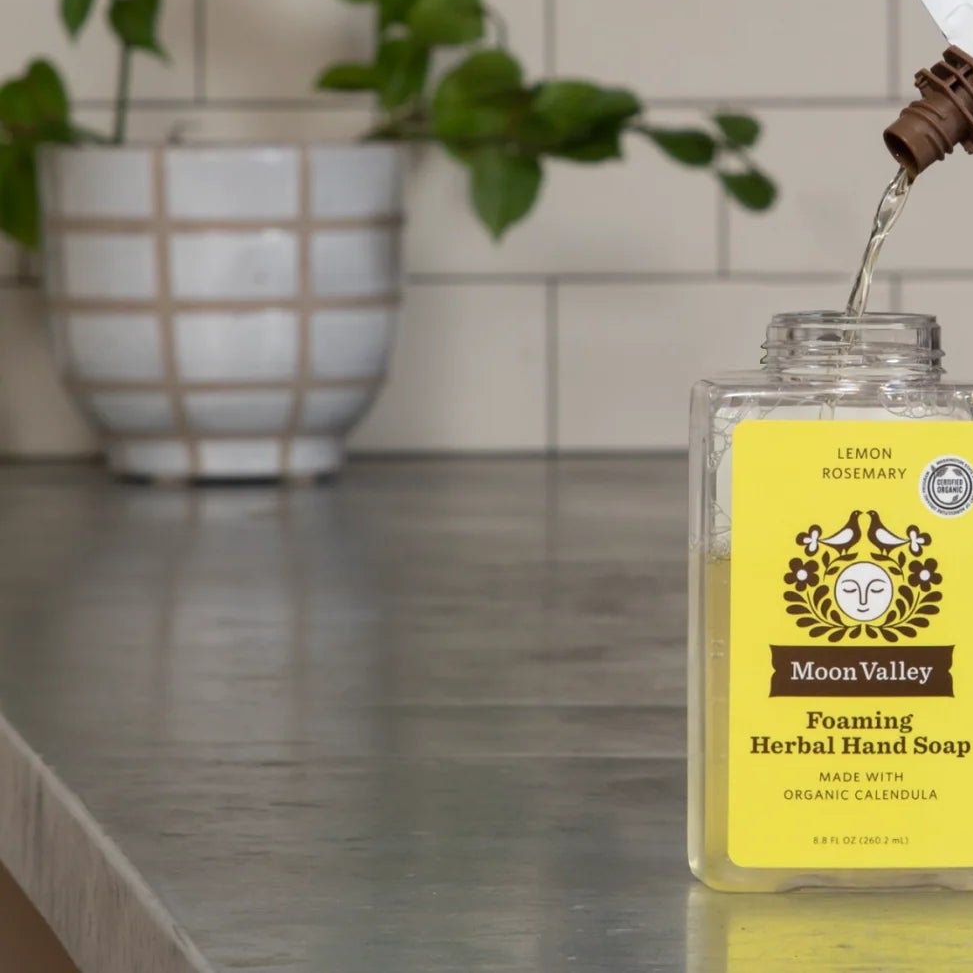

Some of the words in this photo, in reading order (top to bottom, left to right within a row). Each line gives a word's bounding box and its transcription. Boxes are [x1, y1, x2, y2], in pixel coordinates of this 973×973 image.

[837, 447, 893, 460] LEMON
[822, 467, 907, 480] ROSEMARY
[936, 486, 963, 494] ORGANIC
[790, 661, 857, 681] Moon
[860, 661, 932, 684] Valley
[806, 711, 914, 733] Foaming
[750, 736, 835, 755] Herbal
[841, 736, 907, 755] Hand
[913, 736, 971, 758] Soap
[819, 772, 860, 783] MADE
[866, 772, 904, 783] WITH
[783, 789, 849, 801] ORGANIC
[854, 789, 938, 801] CALENDULA
[830, 836, 839, 845] FL
[842, 836, 856, 845] OZ
